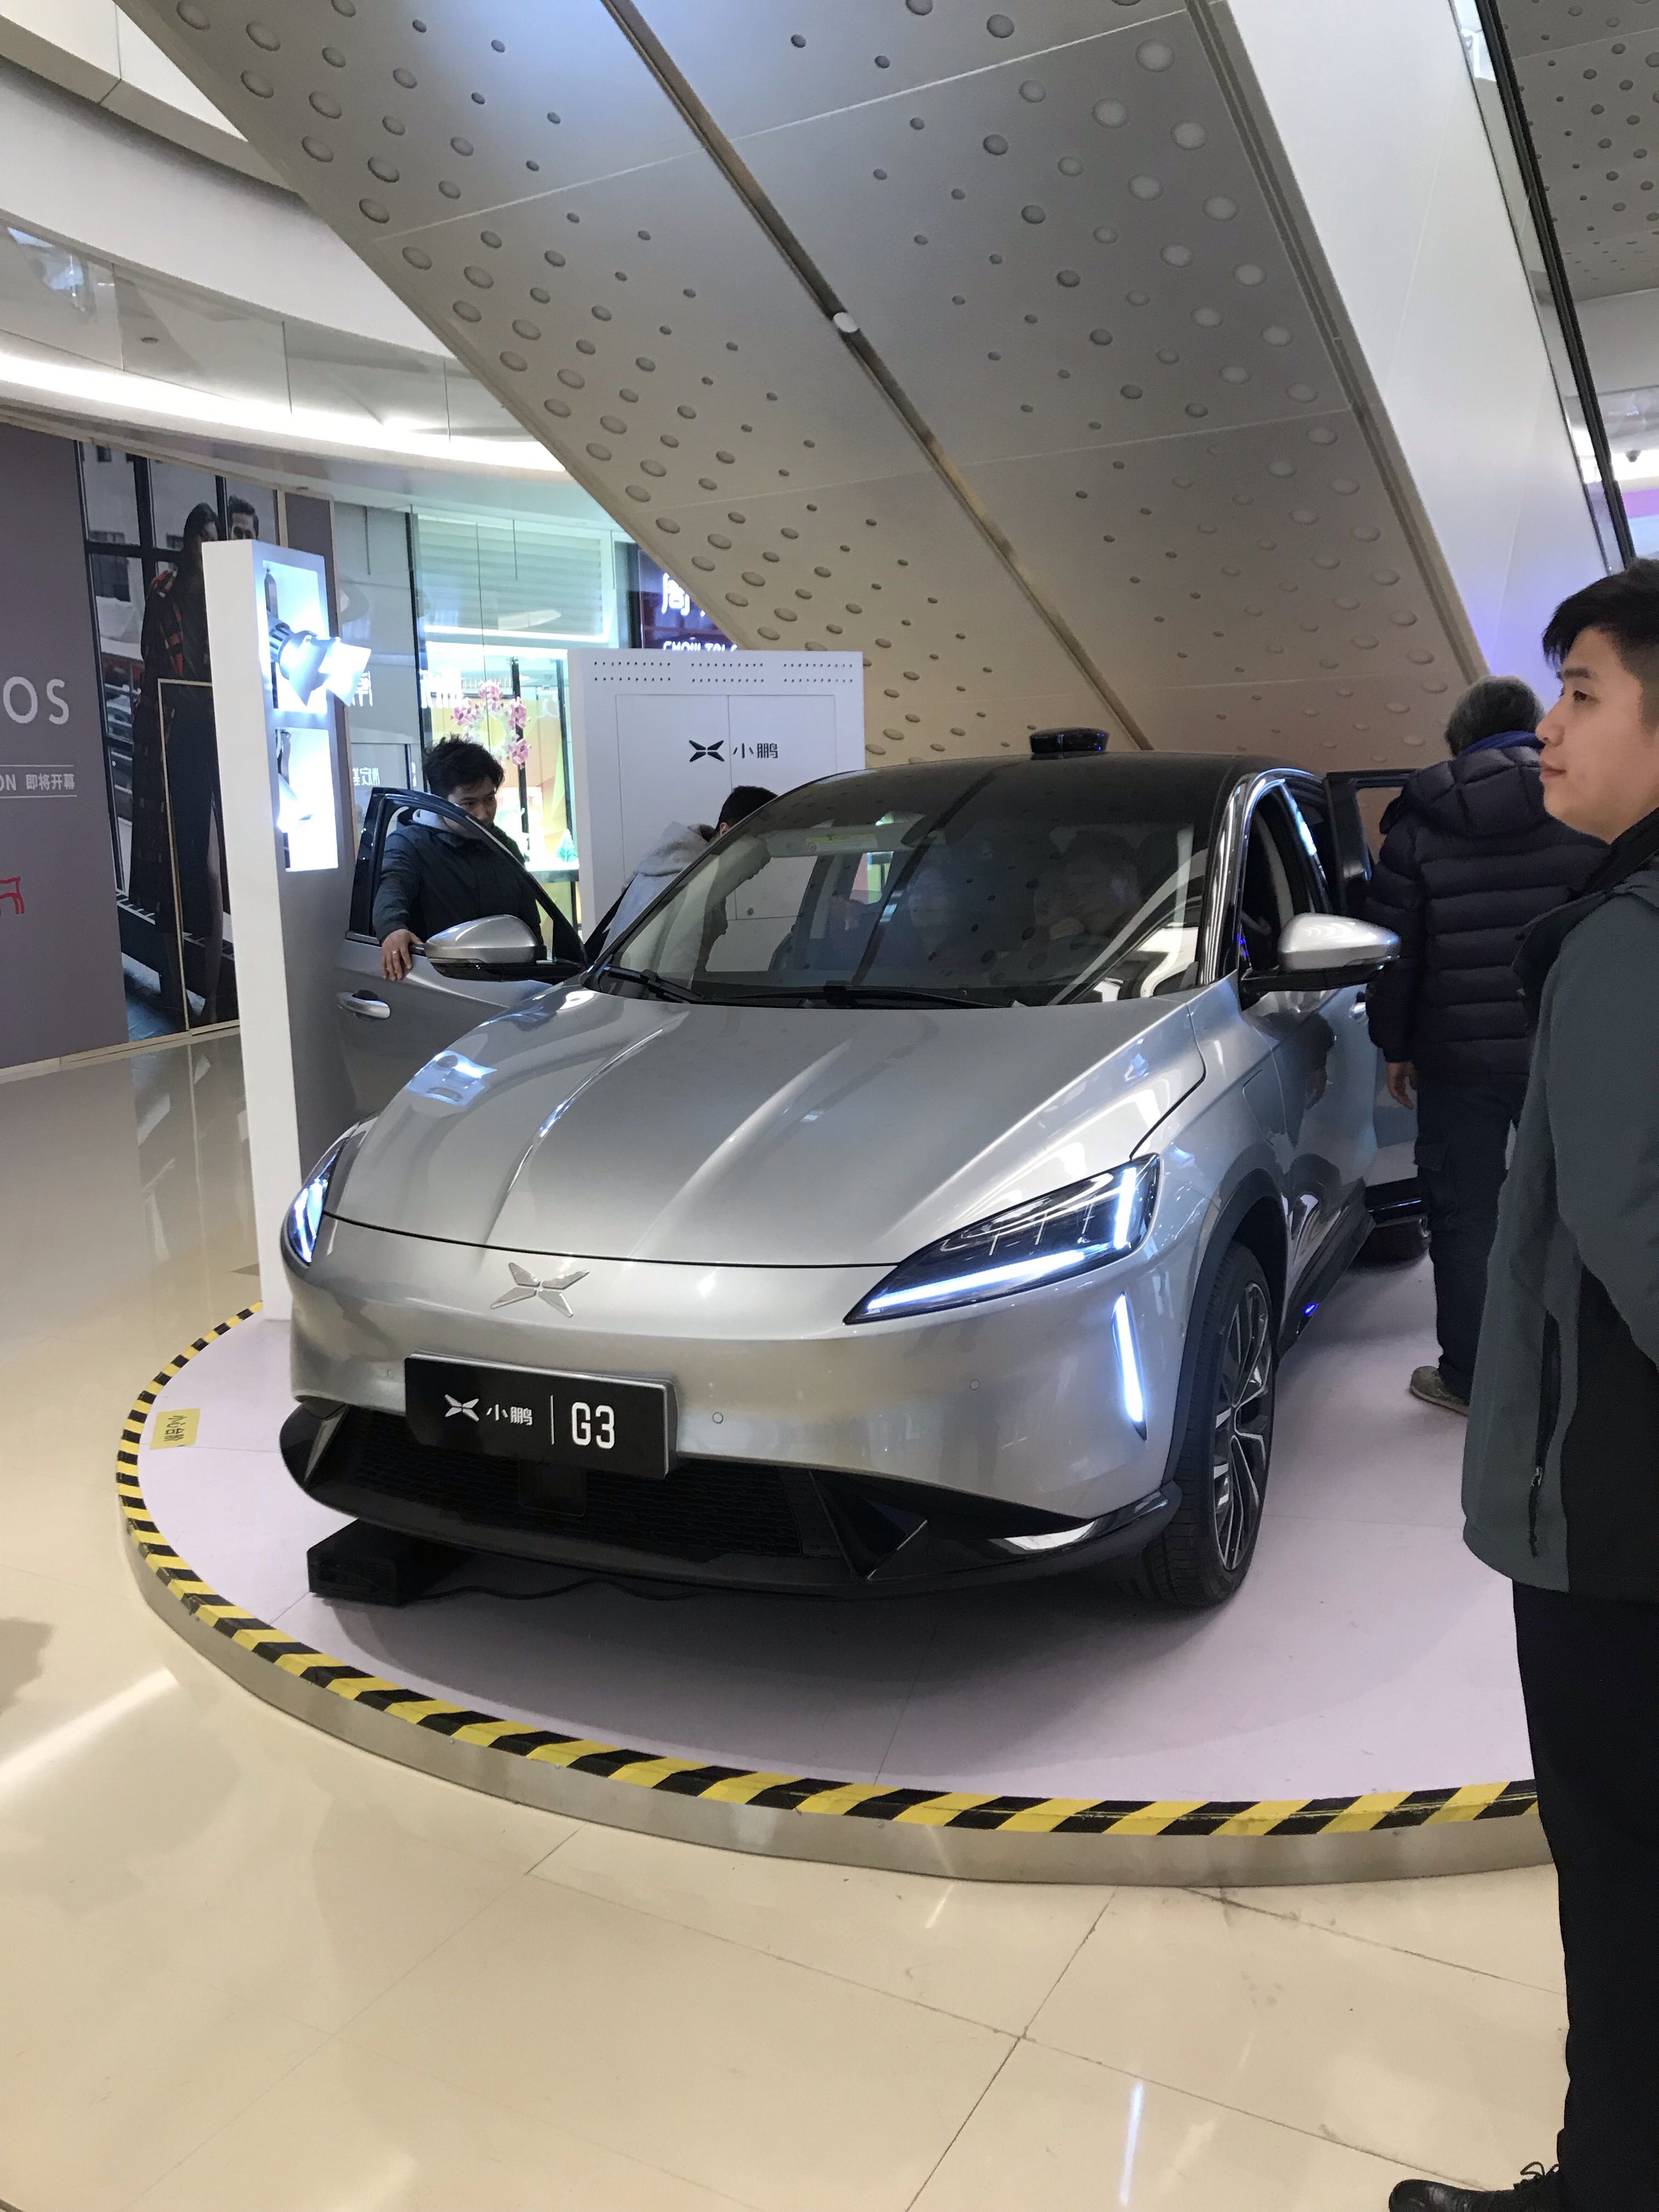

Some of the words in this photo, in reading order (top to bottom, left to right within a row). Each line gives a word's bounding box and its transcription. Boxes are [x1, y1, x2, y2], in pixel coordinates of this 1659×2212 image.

[733, 743, 778, 759] 小鹏
[486, 1404, 532, 1426] 小鹏
[572, 1402, 615, 1449] G3
